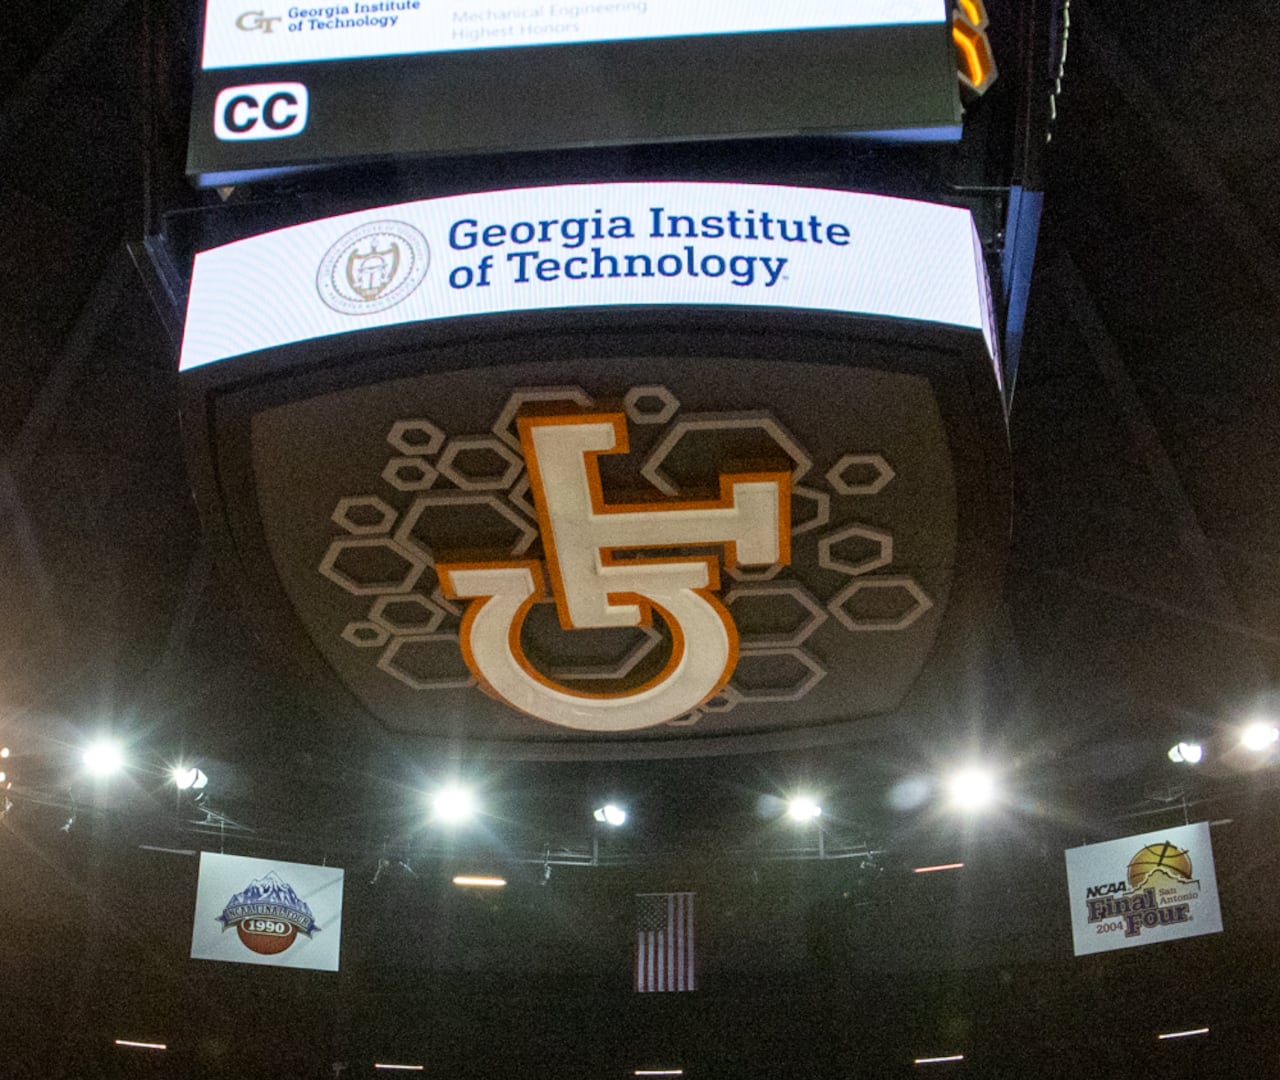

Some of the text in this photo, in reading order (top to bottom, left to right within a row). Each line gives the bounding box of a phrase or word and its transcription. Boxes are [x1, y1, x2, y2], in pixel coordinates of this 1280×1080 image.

[288, 0, 420, 19] Georgia Institute
[452, 1, 648, 23] Mechanical Engineering
[235, 10, 282, 33] GT
[288, 15, 399, 32] of Technology
[452, 22, 579, 41] Highest Honors
[224, 91, 298, 133] CC
[448, 207, 851, 252] Georgia Institute
[448, 255, 494, 289] of
[507, 246, 789, 289] Technology
[1086, 881, 1126, 898] NCAA
[1159, 887, 1177, 897] San
[1160, 892, 1199, 905] Antonio
[1087, 887, 1156, 923] Final
[249, 920, 285, 933] 1990
[1097, 921, 1124, 934] 2004
[1125, 903, 1190, 938] Four
